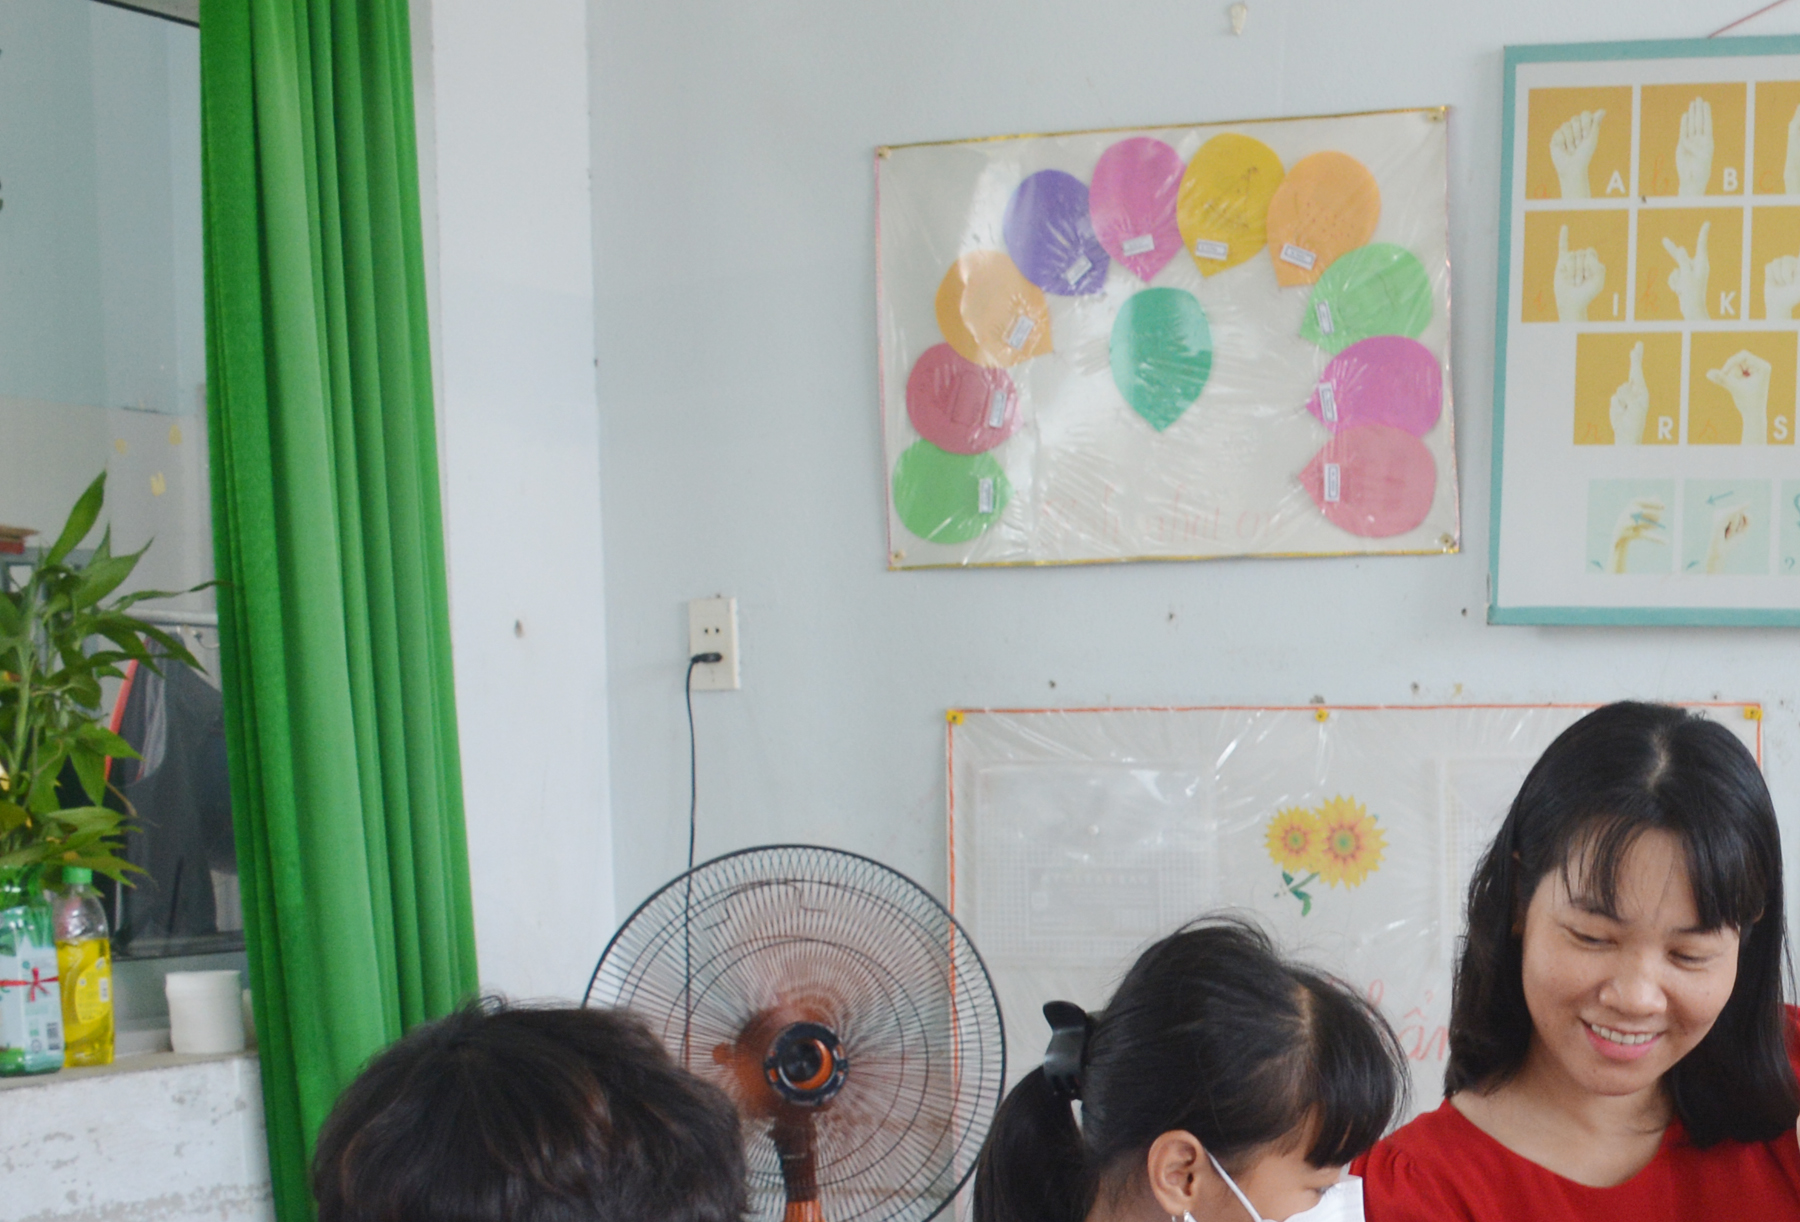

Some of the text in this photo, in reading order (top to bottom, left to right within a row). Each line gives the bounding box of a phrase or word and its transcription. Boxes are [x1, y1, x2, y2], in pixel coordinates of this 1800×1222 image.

[1606, 171, 1626, 194] A
[1723, 168, 1737, 190] B
[1612, 293, 1618, 315] I
[1720, 292, 1735, 315] K
[1658, 416, 1672, 439] R
[1774, 416, 1787, 439] S
